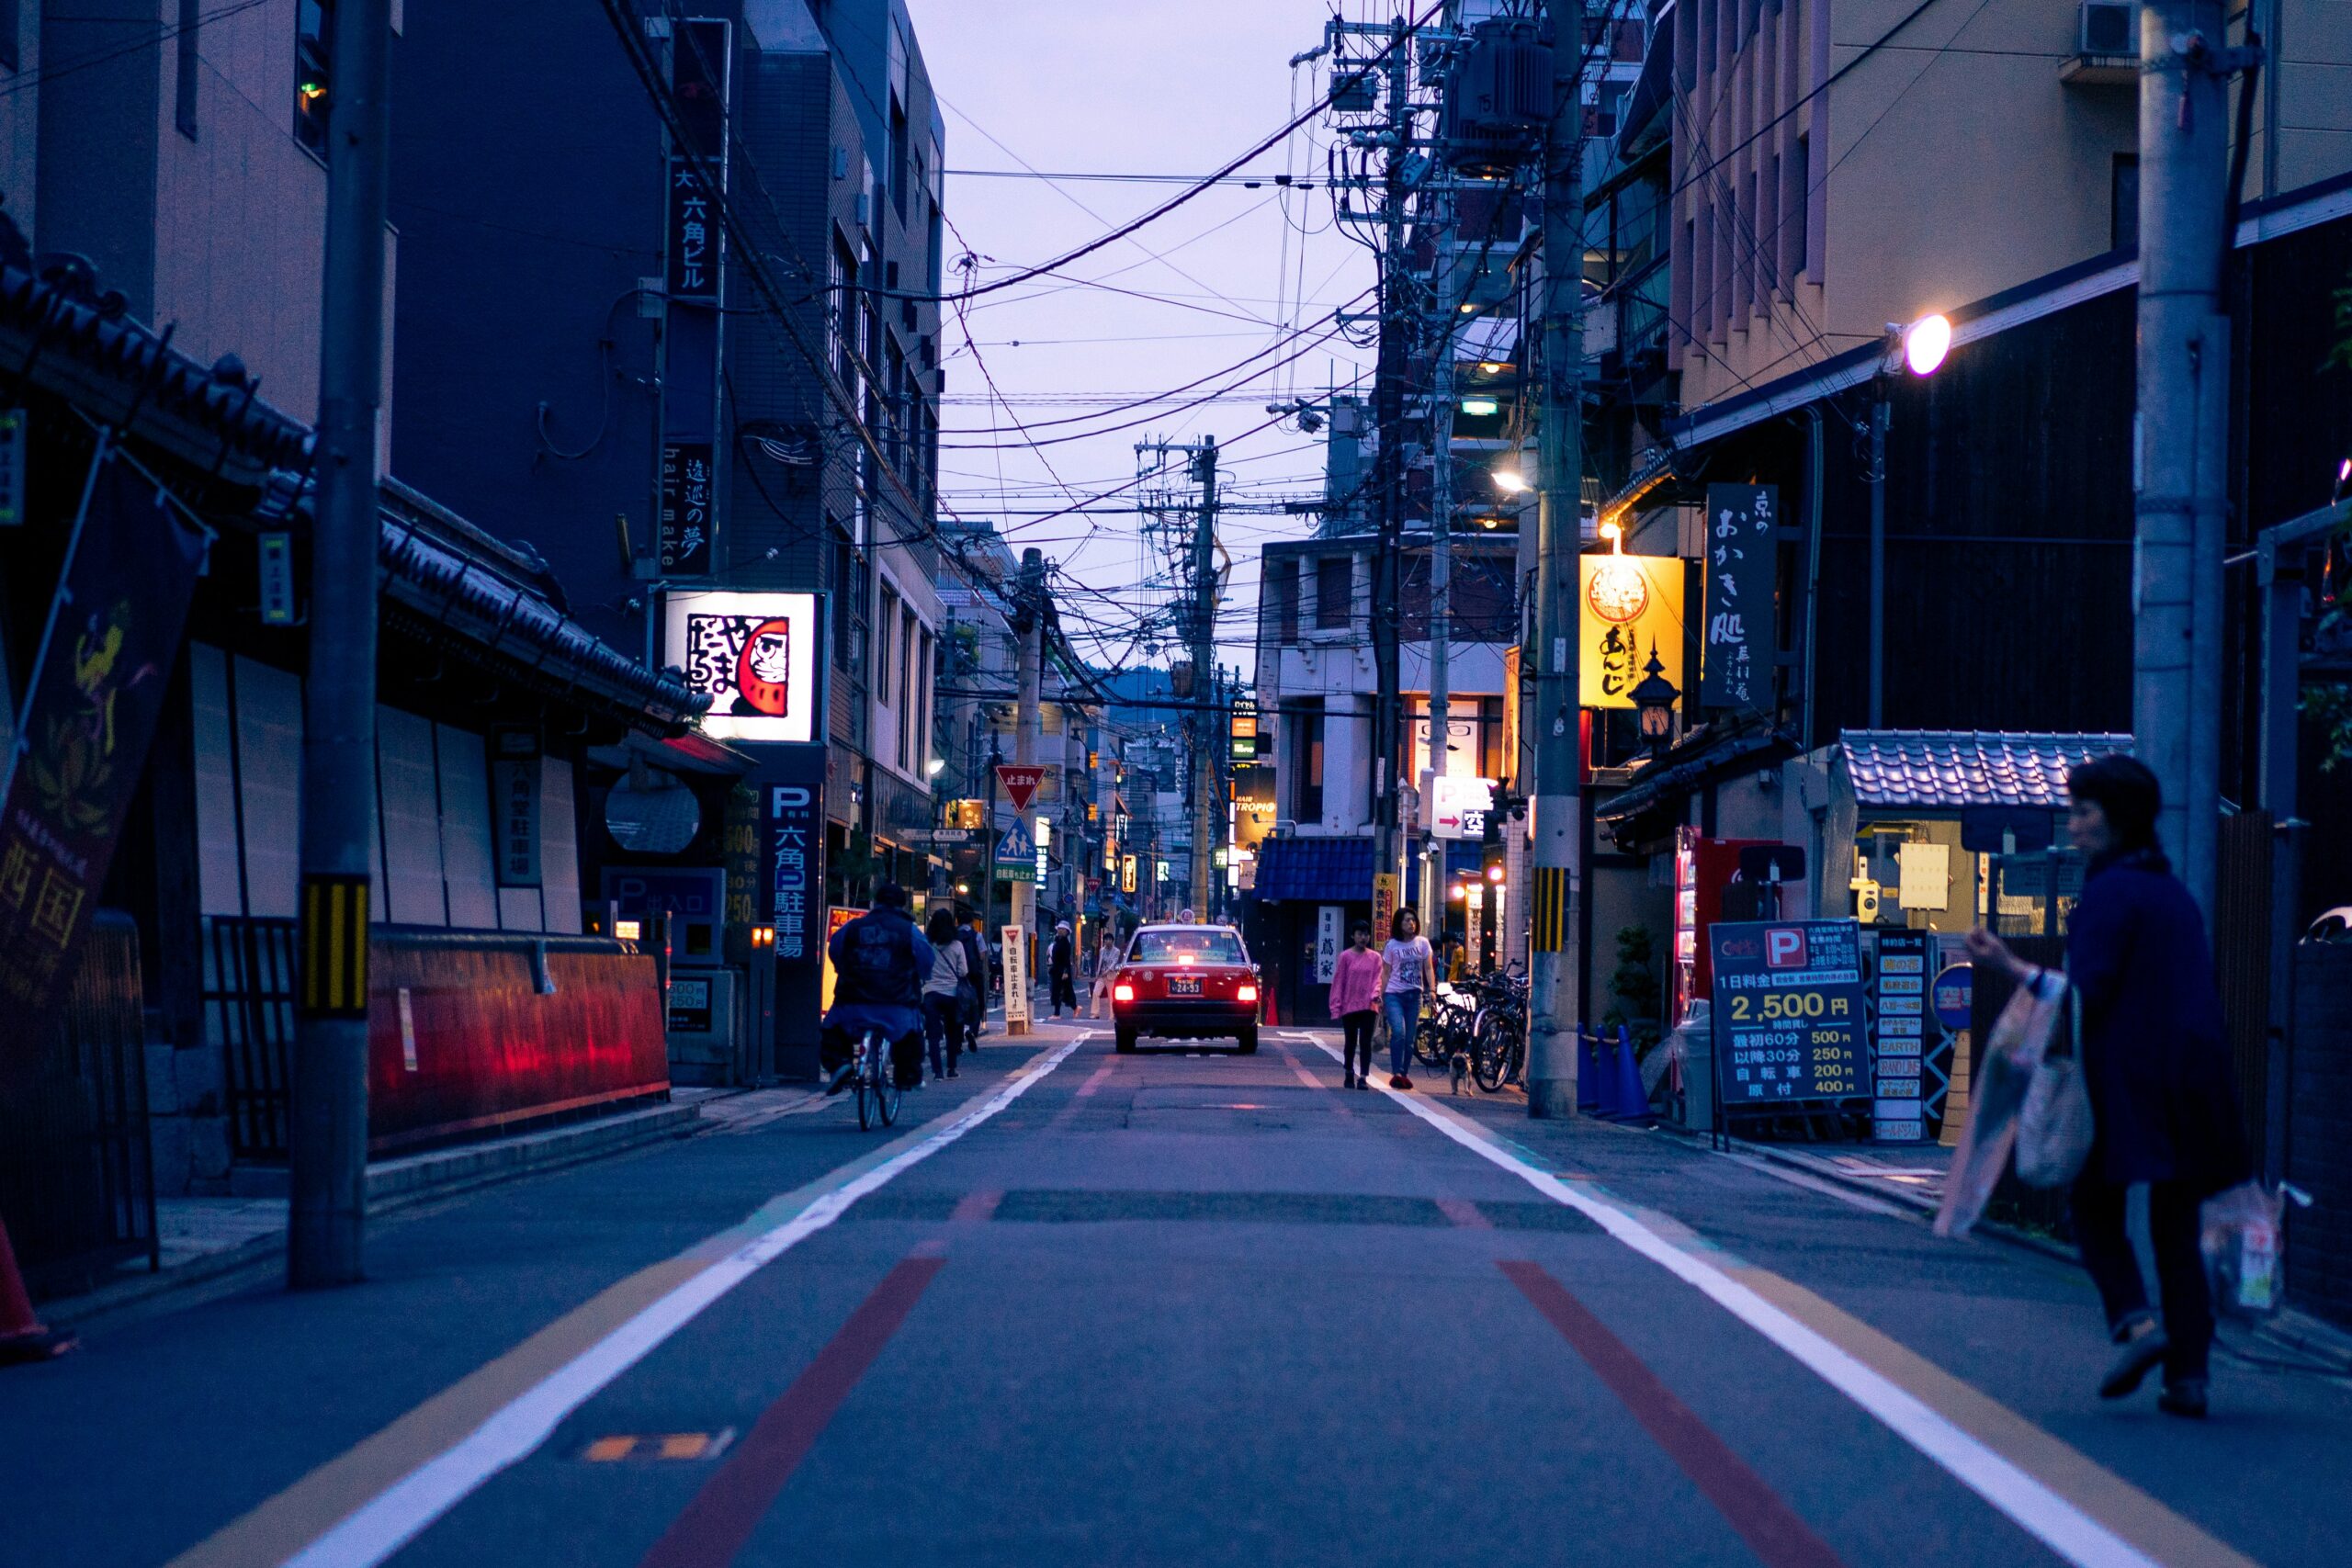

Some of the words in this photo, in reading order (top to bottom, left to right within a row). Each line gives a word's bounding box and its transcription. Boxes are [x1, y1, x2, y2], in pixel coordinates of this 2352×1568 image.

[682, 197, 707, 288] 六角ビル
[664, 448, 681, 496] hair
[662, 509, 679, 566] make
[1710, 509, 1747, 645] おかき処
[1600, 624, 1626, 695] あんじ
[1006, 774, 1036, 786] 止まれ
[773, 787, 810, 818] P
[1770, 931, 1801, 964] P
[1720, 974, 1770, 989] 1日料金
[1734, 1032, 1800, 1048] 最初60分
[1773, 1020, 1809, 1030] 時間貸し
[1735, 1049, 1801, 1065] 以降30分
[1881, 1042, 1919, 1052] EARTH
